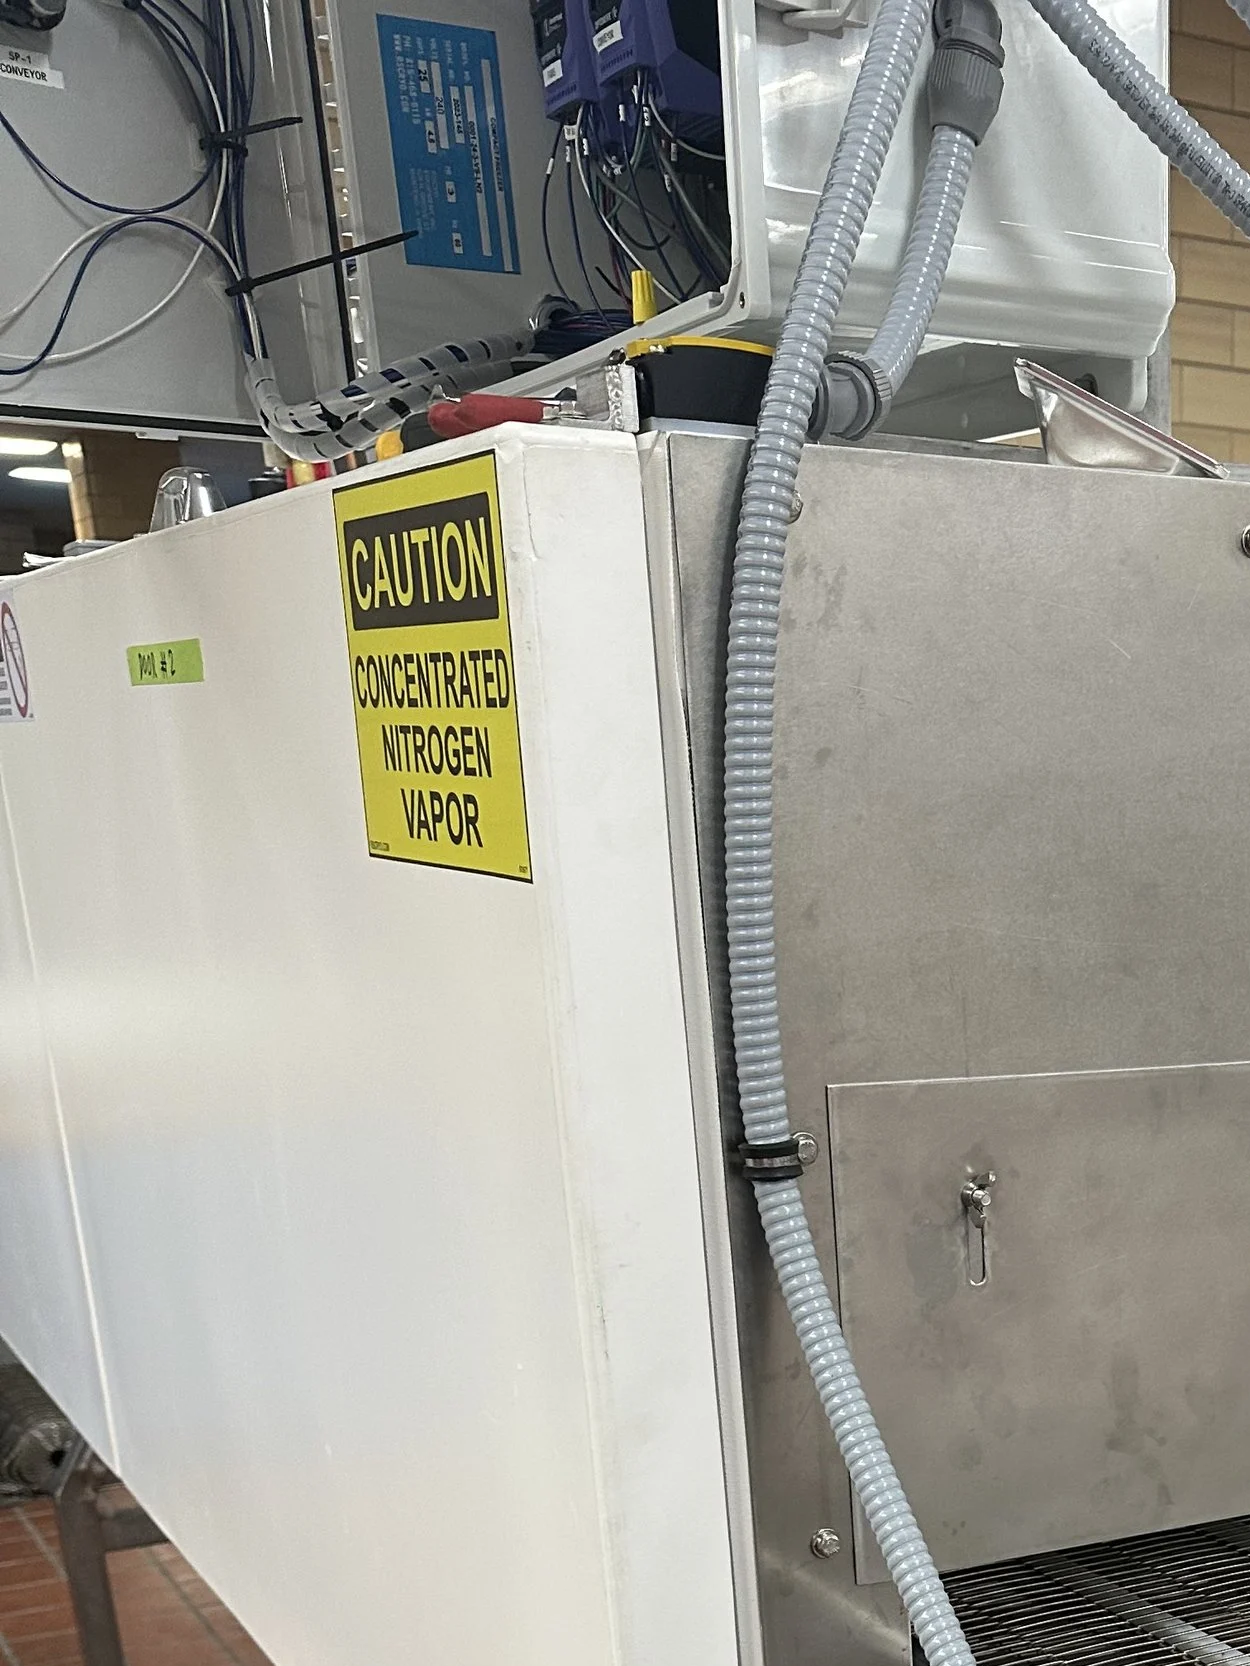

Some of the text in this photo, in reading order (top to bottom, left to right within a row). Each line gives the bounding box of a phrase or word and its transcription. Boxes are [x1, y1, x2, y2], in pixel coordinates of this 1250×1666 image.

[0, 63, 47, 81] CONVEYOR
[8, 51, 31, 64] SP-1
[418, 69, 428, 82] 25
[435, 97, 445, 114] 240
[352, 517, 492, 611] CAUTION
[355, 648, 510, 709] CONCENTRATED
[381, 724, 493, 778] NITROGEN
[400, 788, 484, 848] VAPOR
